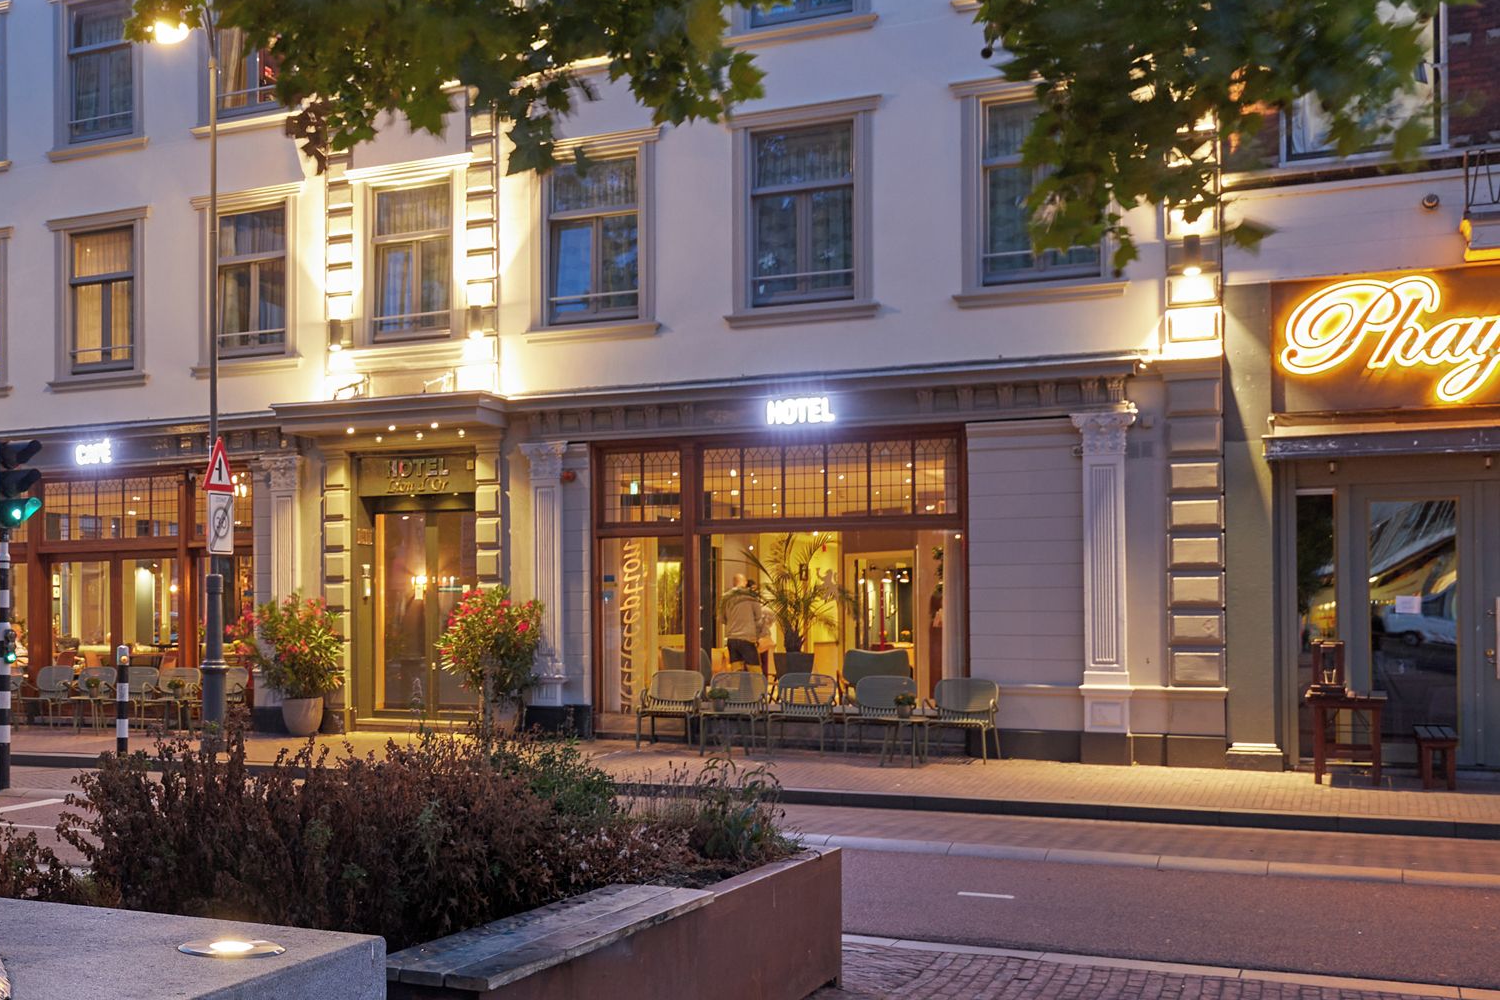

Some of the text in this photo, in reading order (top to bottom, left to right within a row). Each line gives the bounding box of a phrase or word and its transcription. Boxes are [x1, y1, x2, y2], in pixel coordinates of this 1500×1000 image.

[766, 397, 836, 425] HOTEL
[76, 438, 112, 466] CAFÉ
[387, 457, 449, 479] HOTEL
